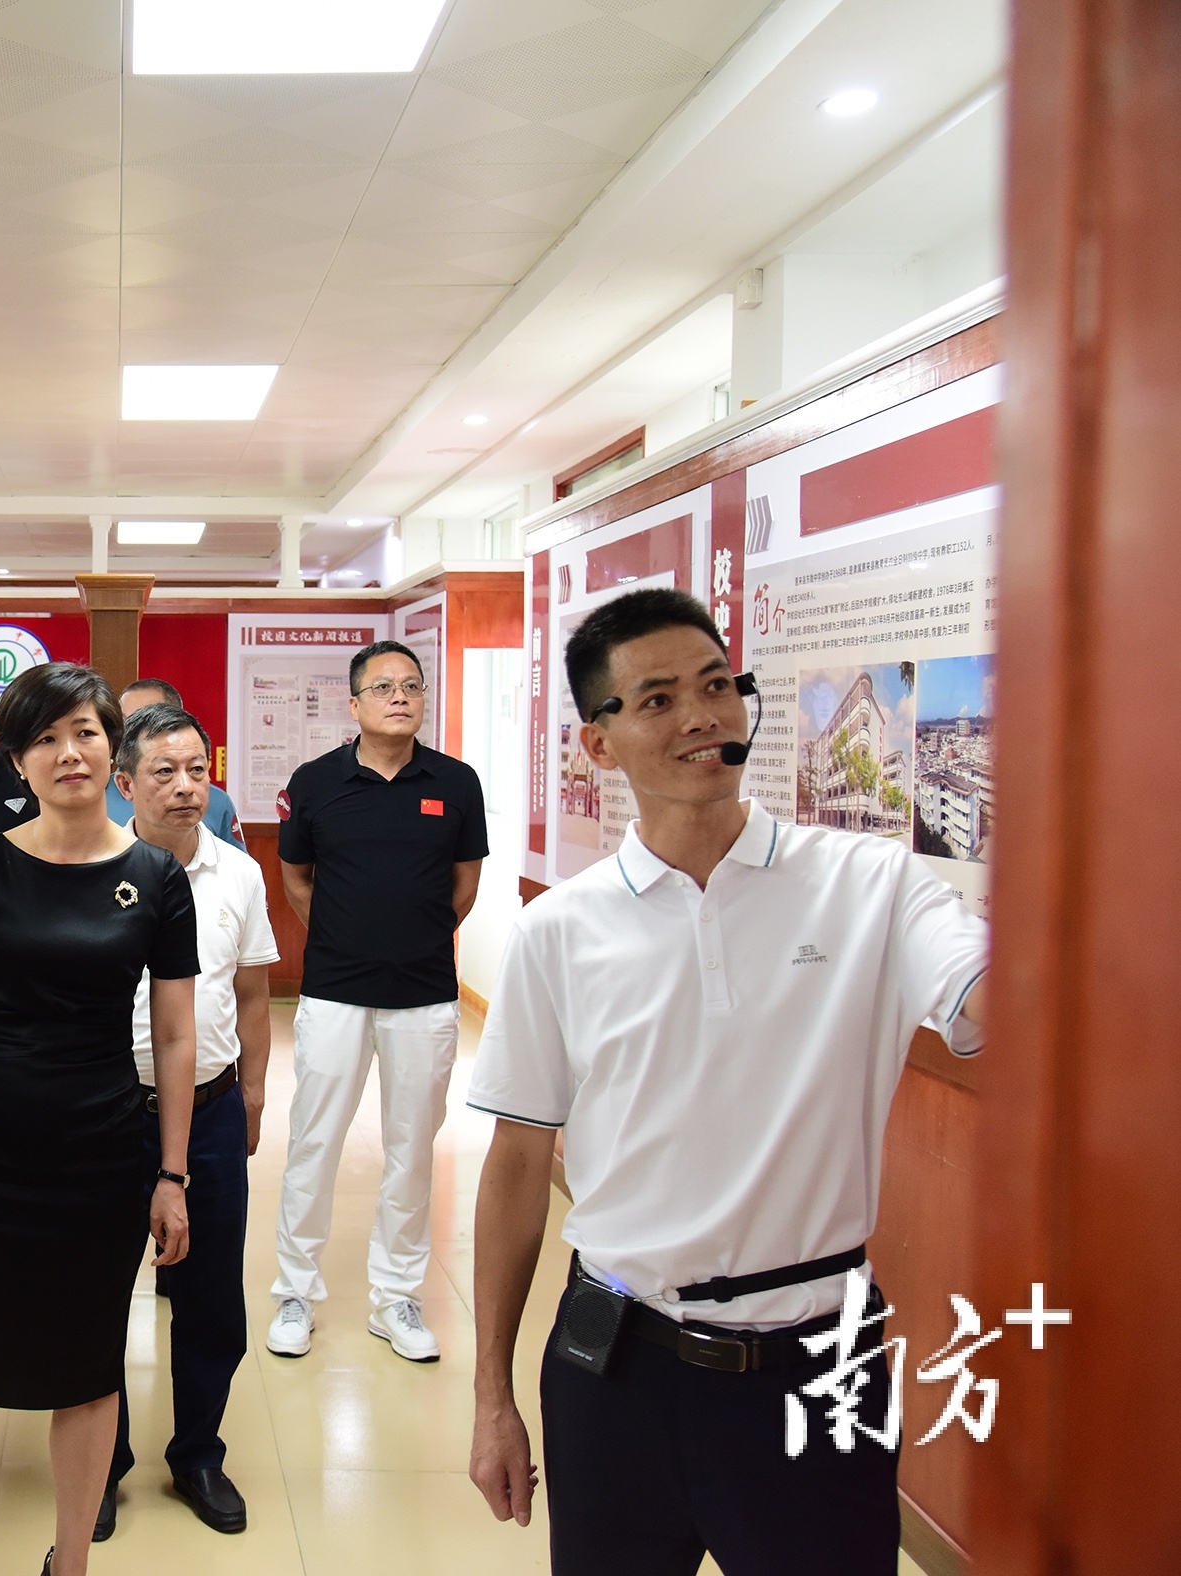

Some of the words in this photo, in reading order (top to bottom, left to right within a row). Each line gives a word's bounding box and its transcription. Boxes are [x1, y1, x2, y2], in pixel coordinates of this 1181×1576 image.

[753, 583, 785, 636] 简介
[260, 630, 363, 643] 校园文化新闻报道
